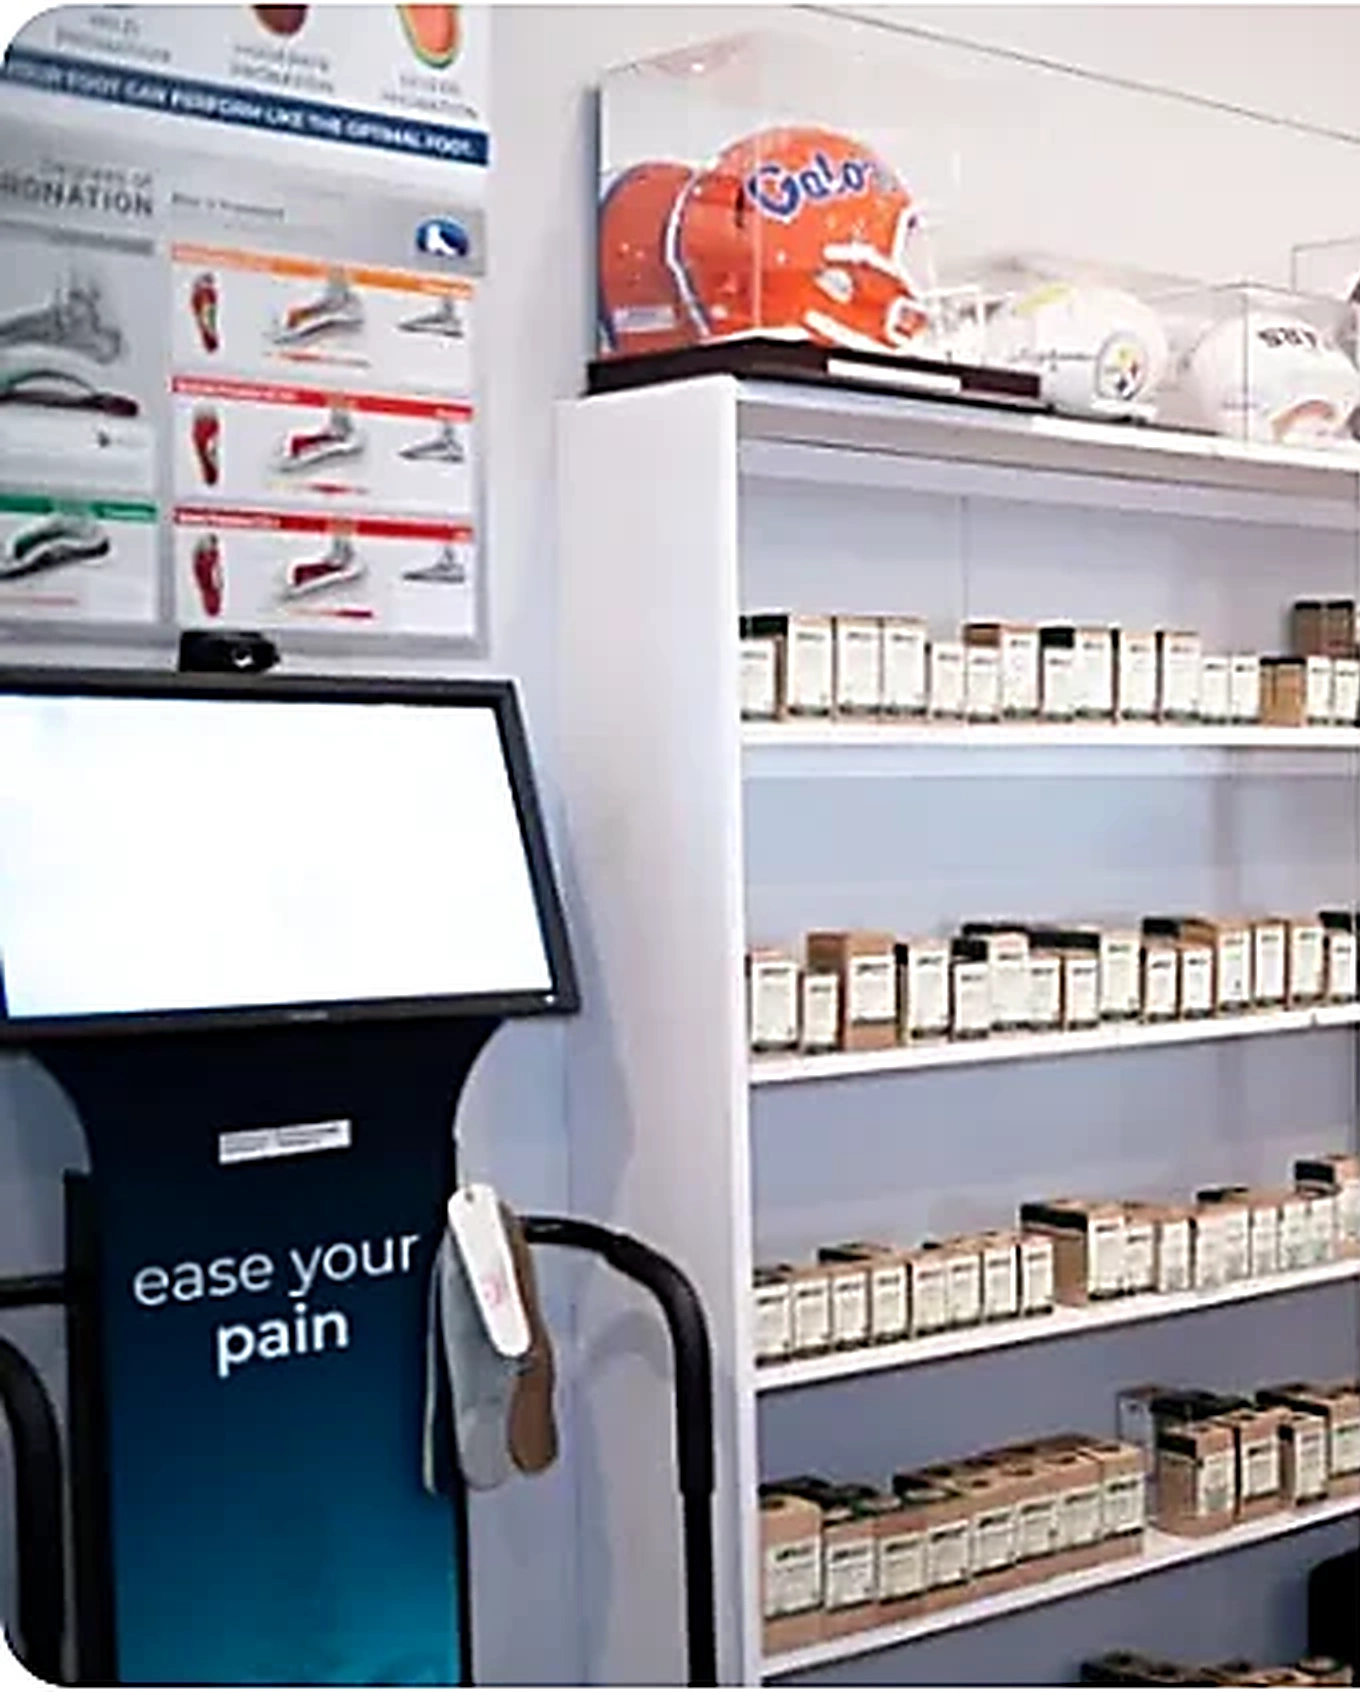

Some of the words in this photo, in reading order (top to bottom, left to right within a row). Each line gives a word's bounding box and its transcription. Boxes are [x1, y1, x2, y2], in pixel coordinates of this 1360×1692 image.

[124, 80, 165, 104] CAN
[171, 88, 262, 120] PERFORM
[265, 104, 303, 128] LIKE
[133, 1252, 274, 1307] ease
[288, 1232, 420, 1298] your
[217, 1302, 350, 1379] pain
